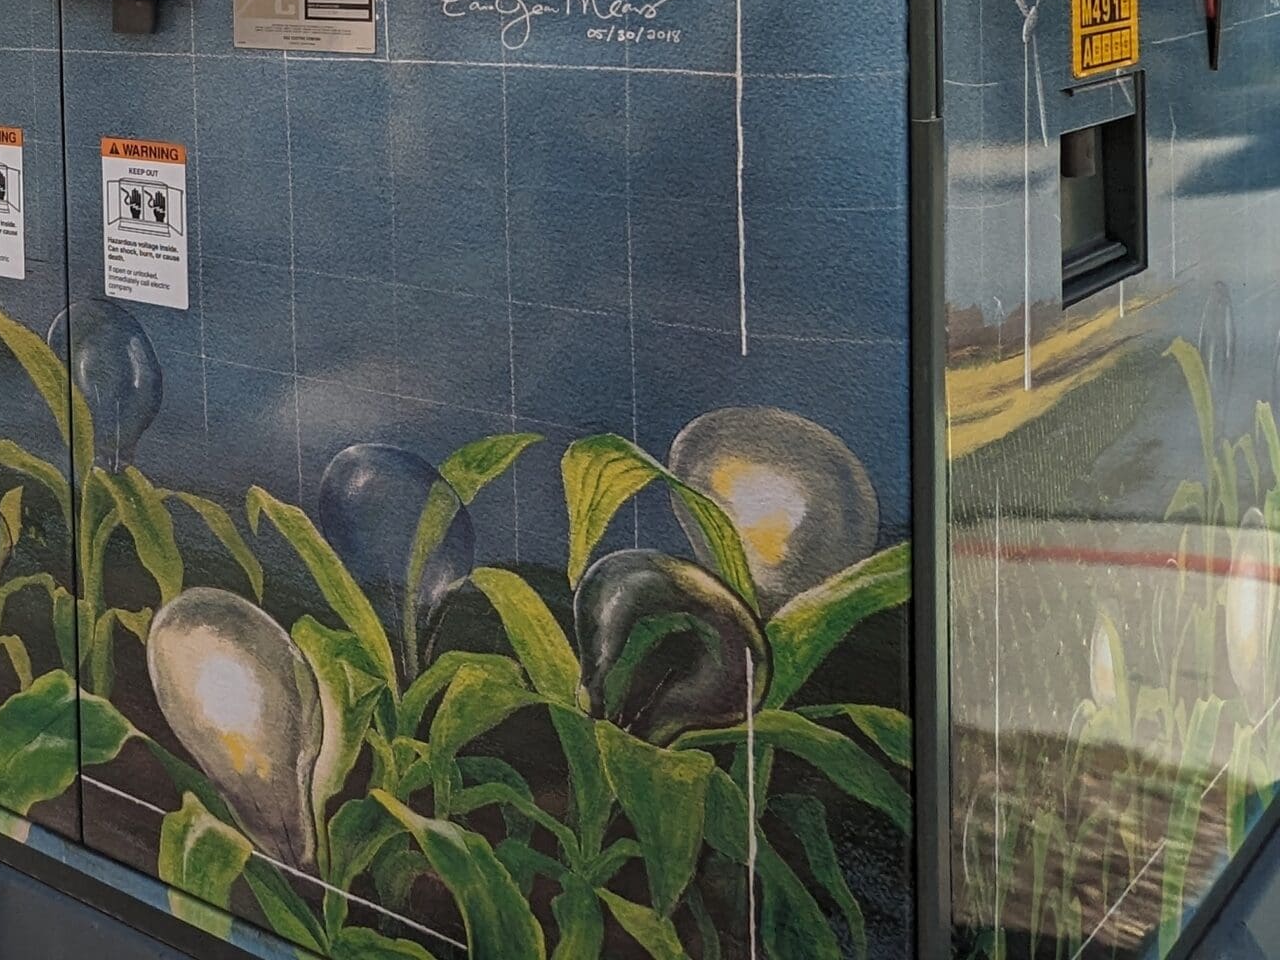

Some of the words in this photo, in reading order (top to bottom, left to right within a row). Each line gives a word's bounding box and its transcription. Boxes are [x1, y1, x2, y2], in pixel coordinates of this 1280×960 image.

[587, 26, 682, 43] 05/30/2018
[1083, 37, 1093, 68] A
[122, 143, 179, 161] WARNING
[128, 167, 145, 176] KEEP
[146, 168, 159, 177] OUT
[107, 236, 137, 247] Hazardous
[138, 241, 159, 251] voltage
[120, 247, 138, 256] shock,
